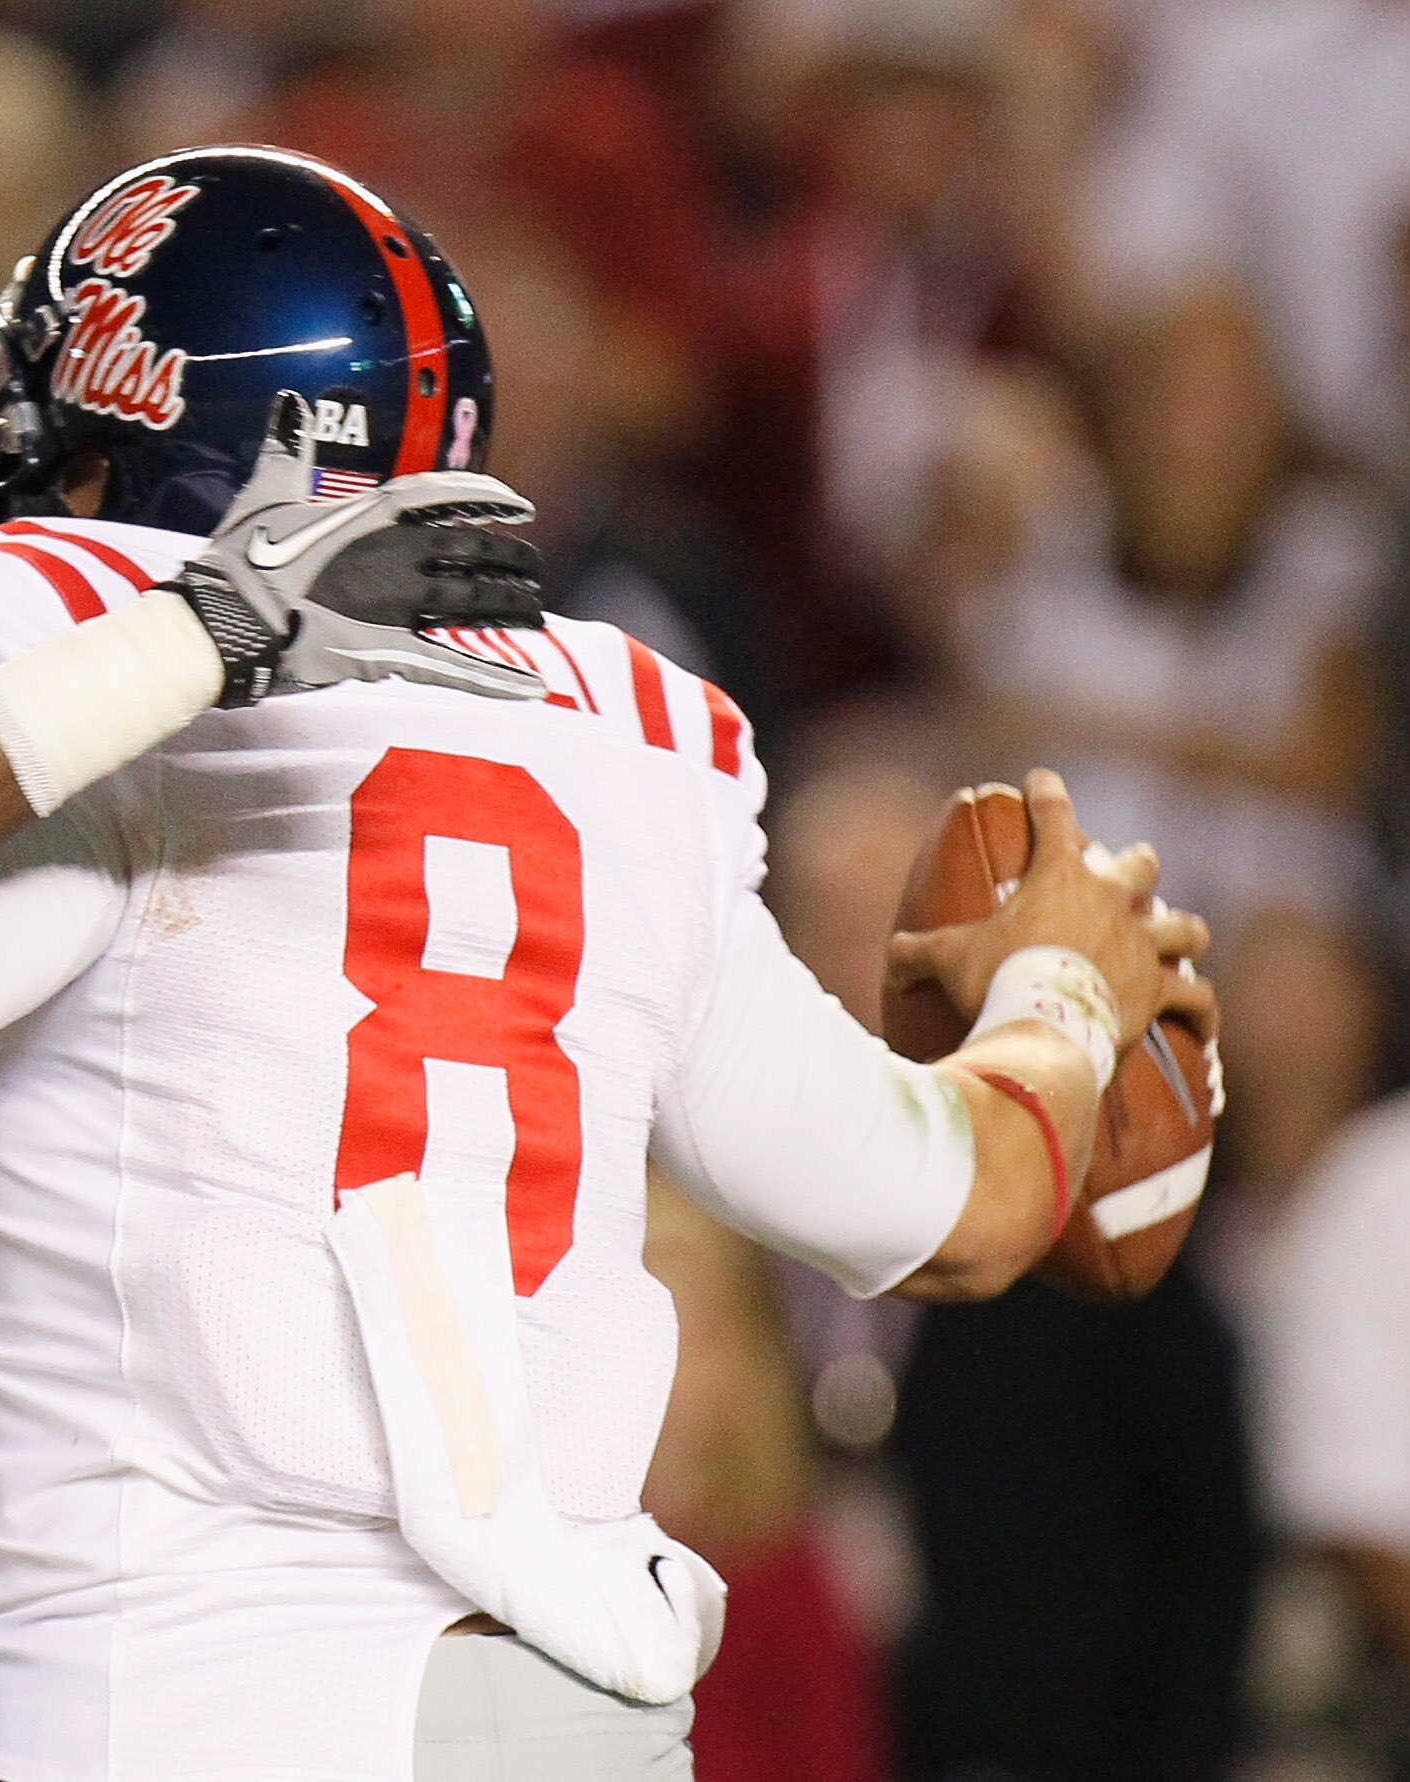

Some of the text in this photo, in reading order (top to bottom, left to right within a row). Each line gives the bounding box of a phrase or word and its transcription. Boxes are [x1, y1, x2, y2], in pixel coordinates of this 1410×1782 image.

[68, 175, 201, 278] Ole
[50, 277, 189, 431] Miss
[308, 399, 370, 447] BA
[334, 746, 585, 1298] 8
